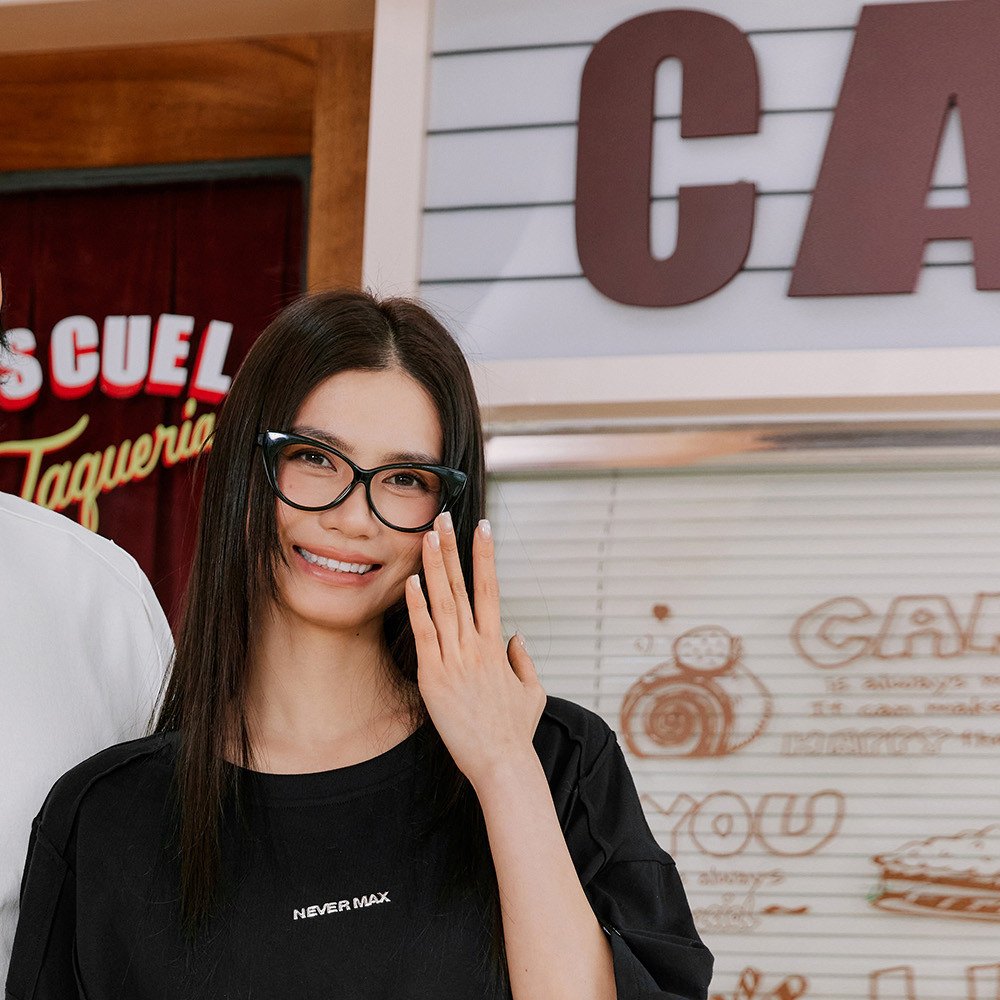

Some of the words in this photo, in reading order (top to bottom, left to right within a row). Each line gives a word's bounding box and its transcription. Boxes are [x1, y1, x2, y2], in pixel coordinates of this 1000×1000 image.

[640, 788, 847, 860] YOU
[293, 899, 352, 920] NEVER
[352, 891, 392, 909] MAX
